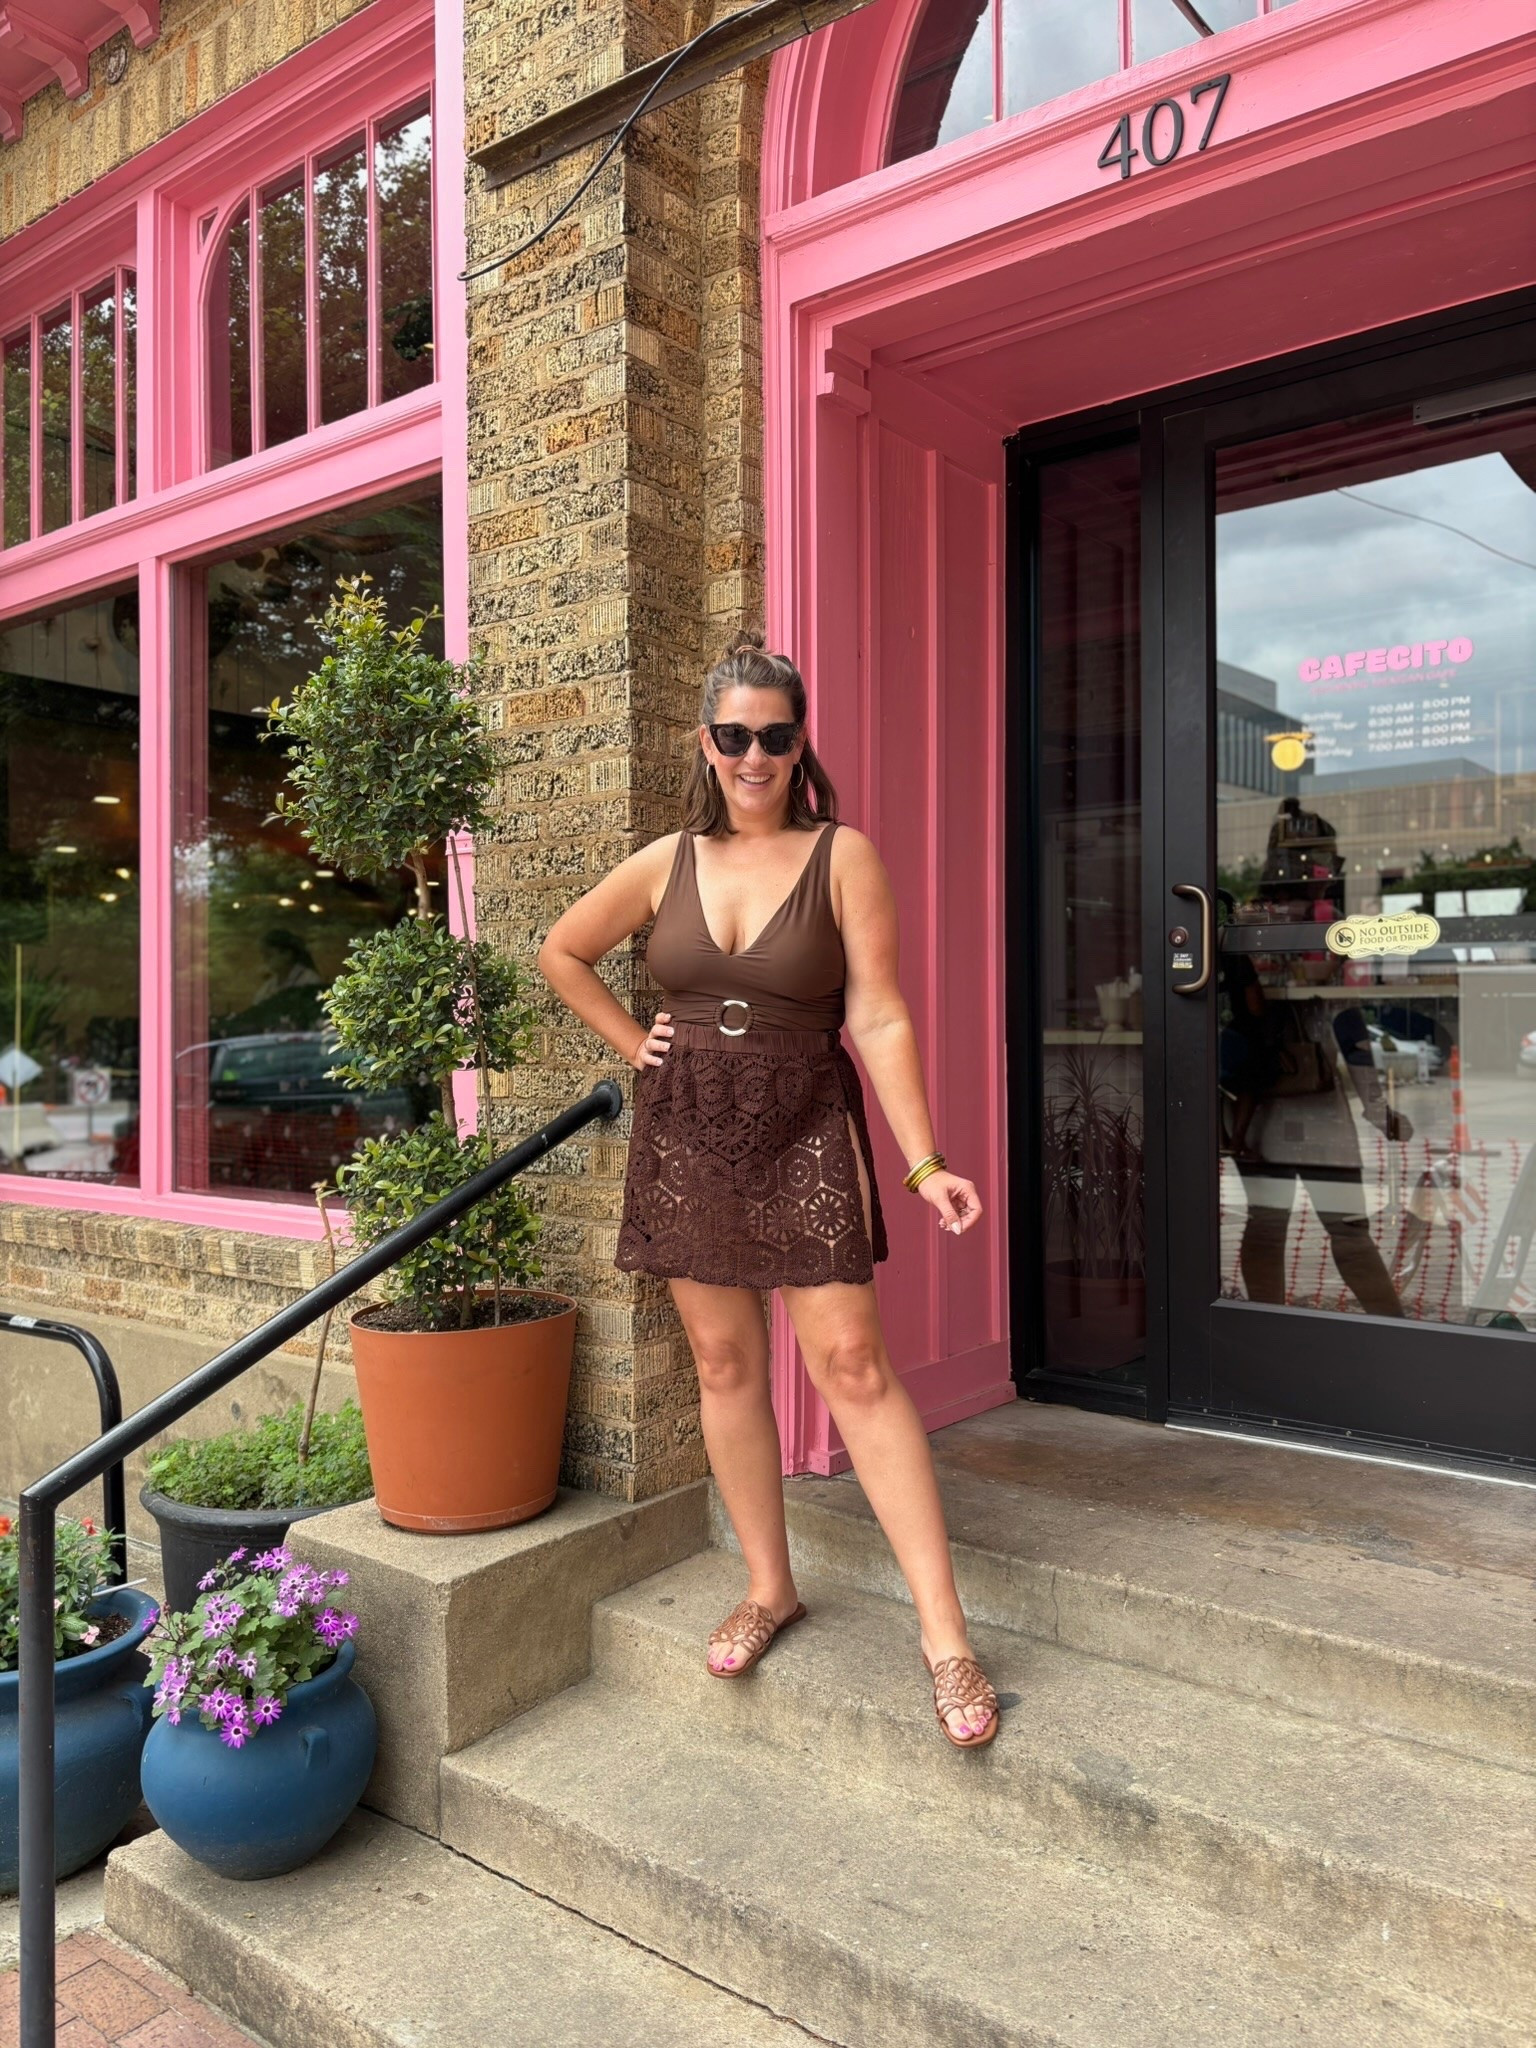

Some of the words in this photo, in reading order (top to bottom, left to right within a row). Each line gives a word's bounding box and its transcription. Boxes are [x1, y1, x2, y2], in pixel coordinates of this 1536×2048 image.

[1097, 73, 1231, 179] 407
[1298, 636, 1474, 684] CAFECITO
[1395, 702, 1414, 711] AM
[1451, 696, 1471, 706] PM
[1395, 715, 1414, 724] AM
[1450, 709, 1470, 719] PM
[1395, 728, 1414, 737] AM
[1451, 722, 1470, 732] PM
[1395, 741, 1414, 750] AM
[1450, 736, 1470, 745] PM
[1359, 928, 1376, 936] NO
[1380, 923, 1430, 935] OUTSIDE
[1400, 933, 1429, 942] DRINK
